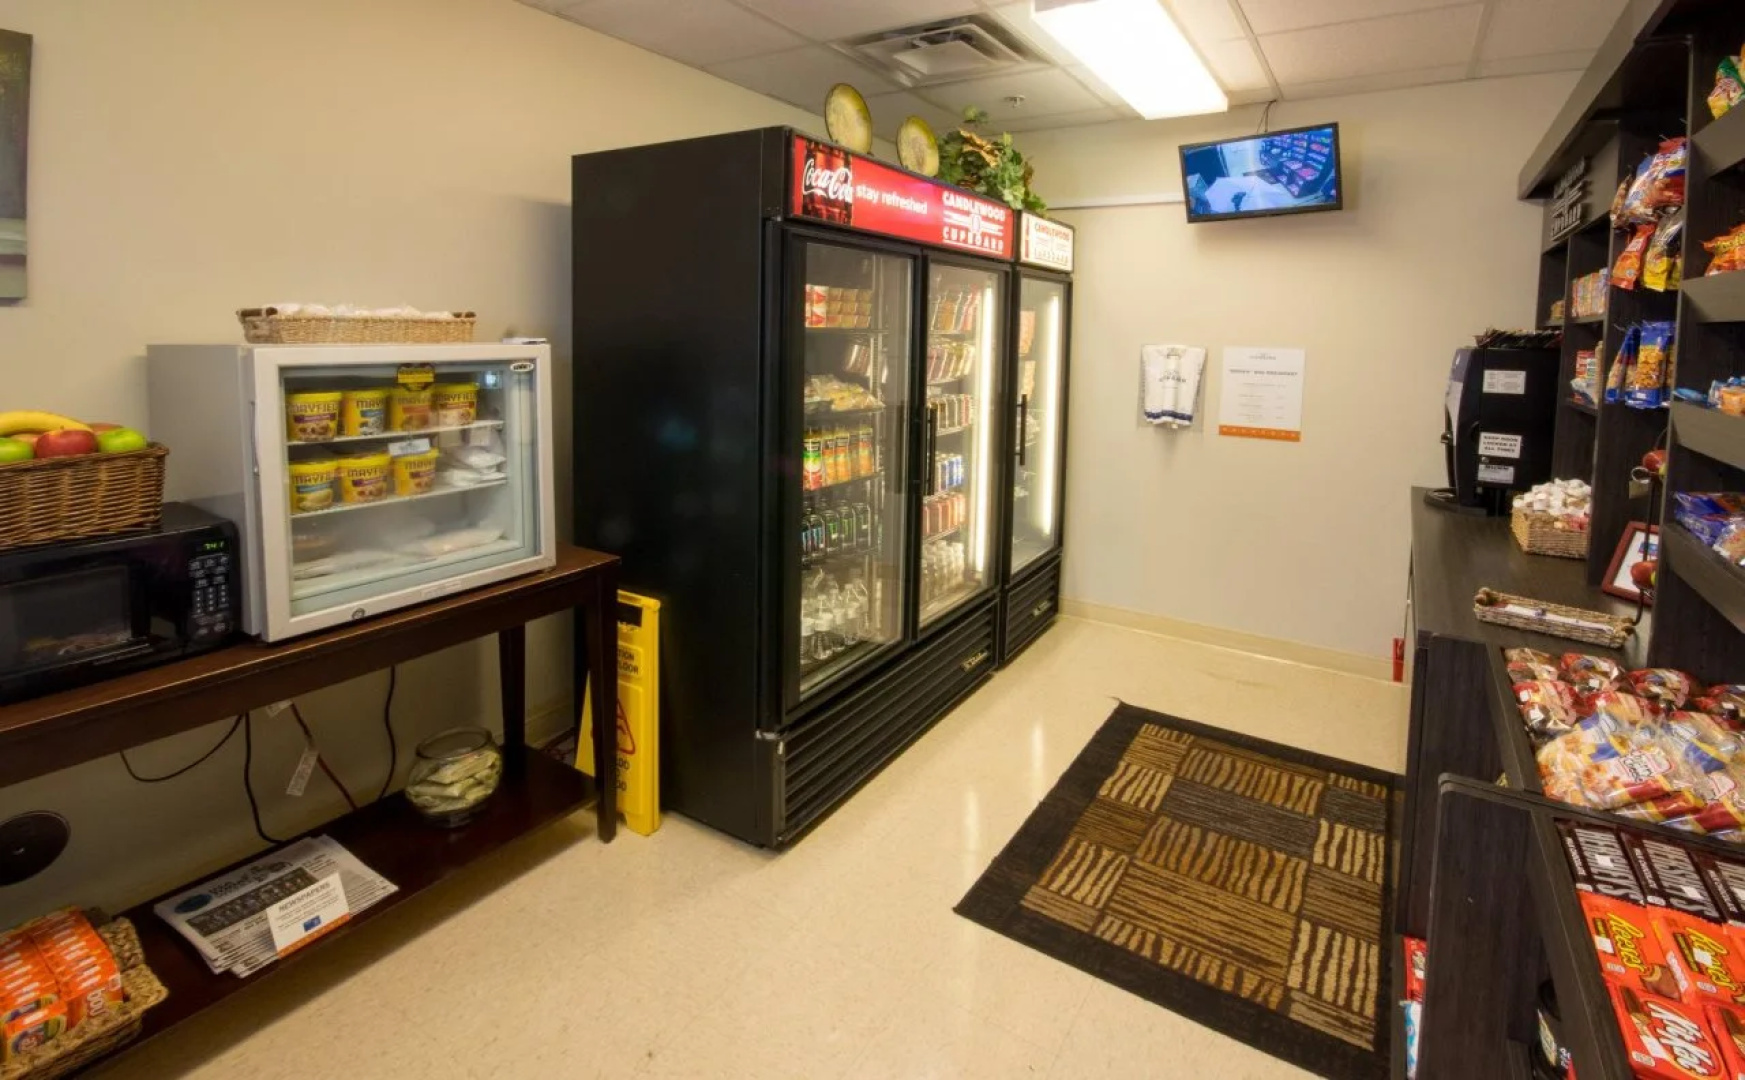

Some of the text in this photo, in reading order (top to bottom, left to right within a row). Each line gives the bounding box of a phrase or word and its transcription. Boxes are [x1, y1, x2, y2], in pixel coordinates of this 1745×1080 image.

[856, 185, 928, 214] stay refreshed
[942, 190, 1006, 221] CANDLEWOOD
[942, 226, 1004, 252] CUPBOARD
[617, 659, 639, 675] LOOR
[279, 881, 331, 911] NEWSPAPERS
